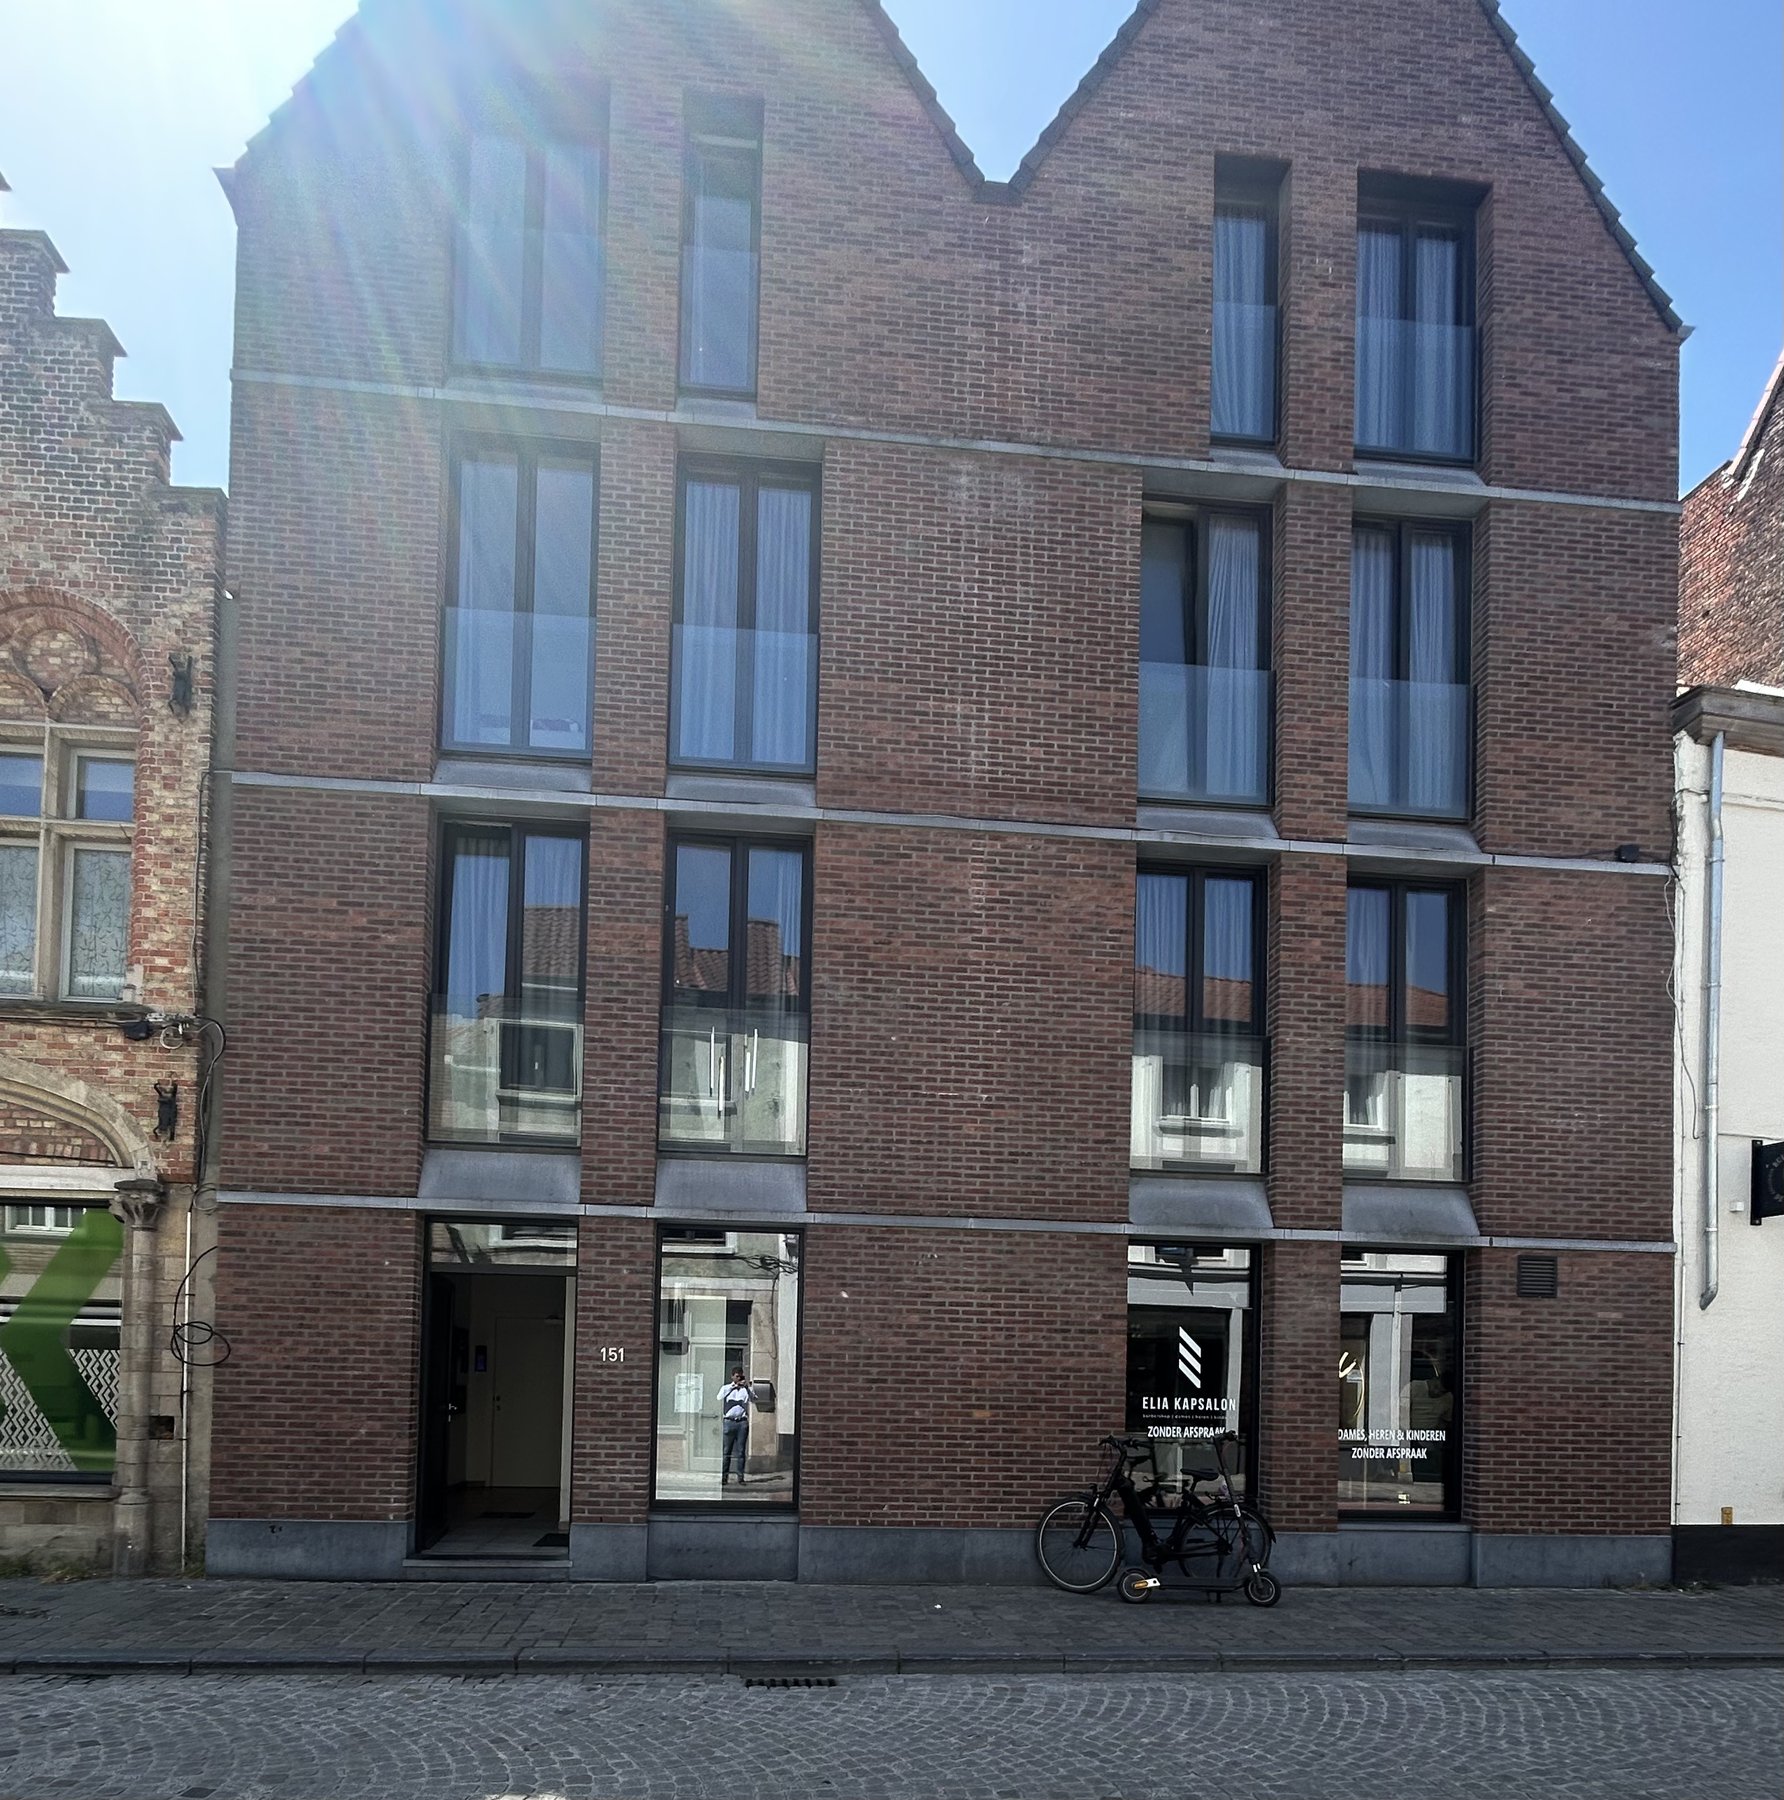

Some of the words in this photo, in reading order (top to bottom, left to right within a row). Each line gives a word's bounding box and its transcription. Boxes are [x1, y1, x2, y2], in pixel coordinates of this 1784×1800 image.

[600, 1347, 625, 1362] 151
[1142, 1396, 1169, 1410] ELIA
[1174, 1397, 1236, 1411] KAPSALON
[1147, 1426, 1182, 1438] ZONDER
[1337, 1429, 1368, 1441] DAMES,
[1369, 1429, 1396, 1440] HEREN
[1397, 1430, 1405, 1440] &
[1406, 1430, 1446, 1441] KINDEREN
[1351, 1448, 1385, 1459] ZONDER
[1386, 1448, 1428, 1459] AFSPRAAK
